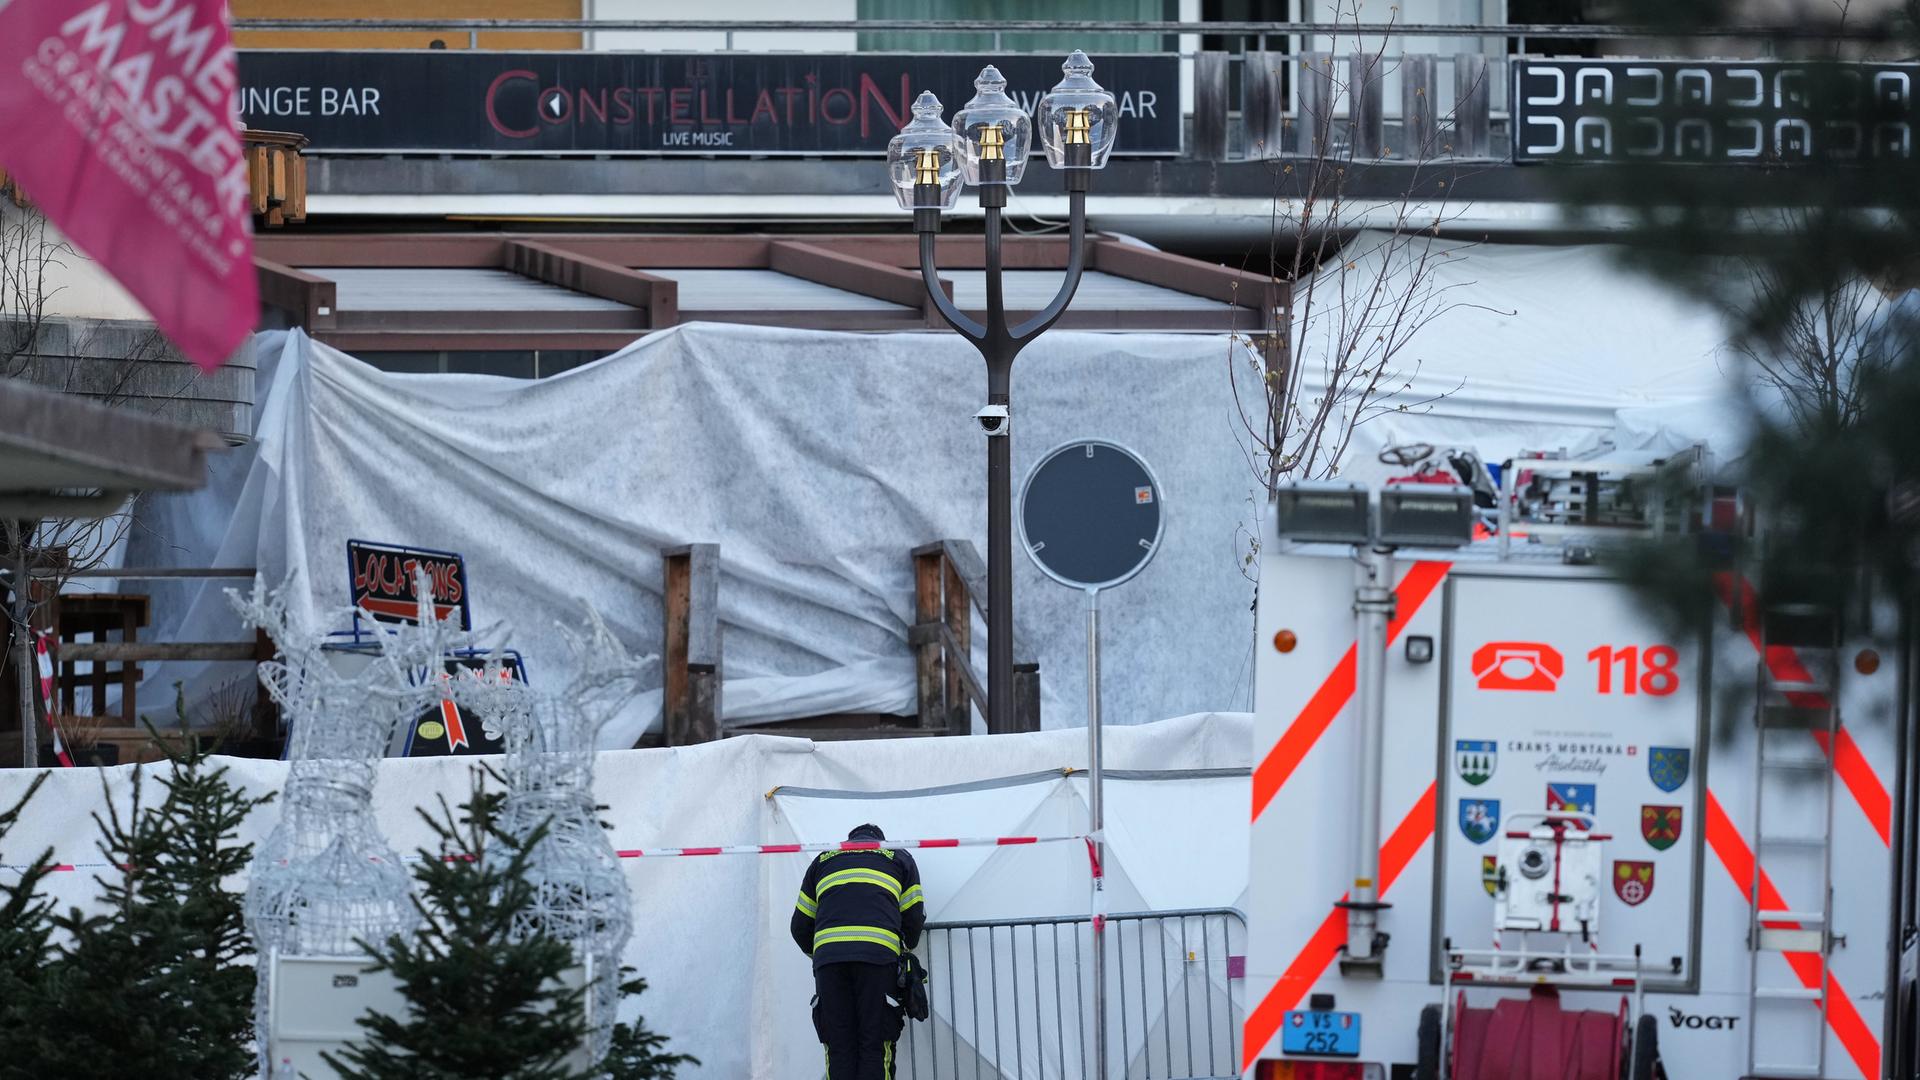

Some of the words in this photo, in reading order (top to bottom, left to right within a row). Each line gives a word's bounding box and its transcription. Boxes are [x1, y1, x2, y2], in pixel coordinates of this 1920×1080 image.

[321, 87, 380, 116] BAR
[1105, 90, 1157, 119] AR
[662, 132, 689, 147] LIVE
[692, 132, 734, 147] MUSIC
[107, 119, 224, 239] MONTANA
[353, 550, 462, 603] LOCATONS
[1587, 643, 1680, 697] 118
[1507, 740, 1552, 753] CRANS
[1558, 742, 1624, 755] MONTANA
[1534, 752, 1608, 777] Absolutely
[1312, 1013, 1331, 1029] VS
[1669, 1010, 1741, 1030] VOGT
[1305, 1031, 1340, 1052] 252
